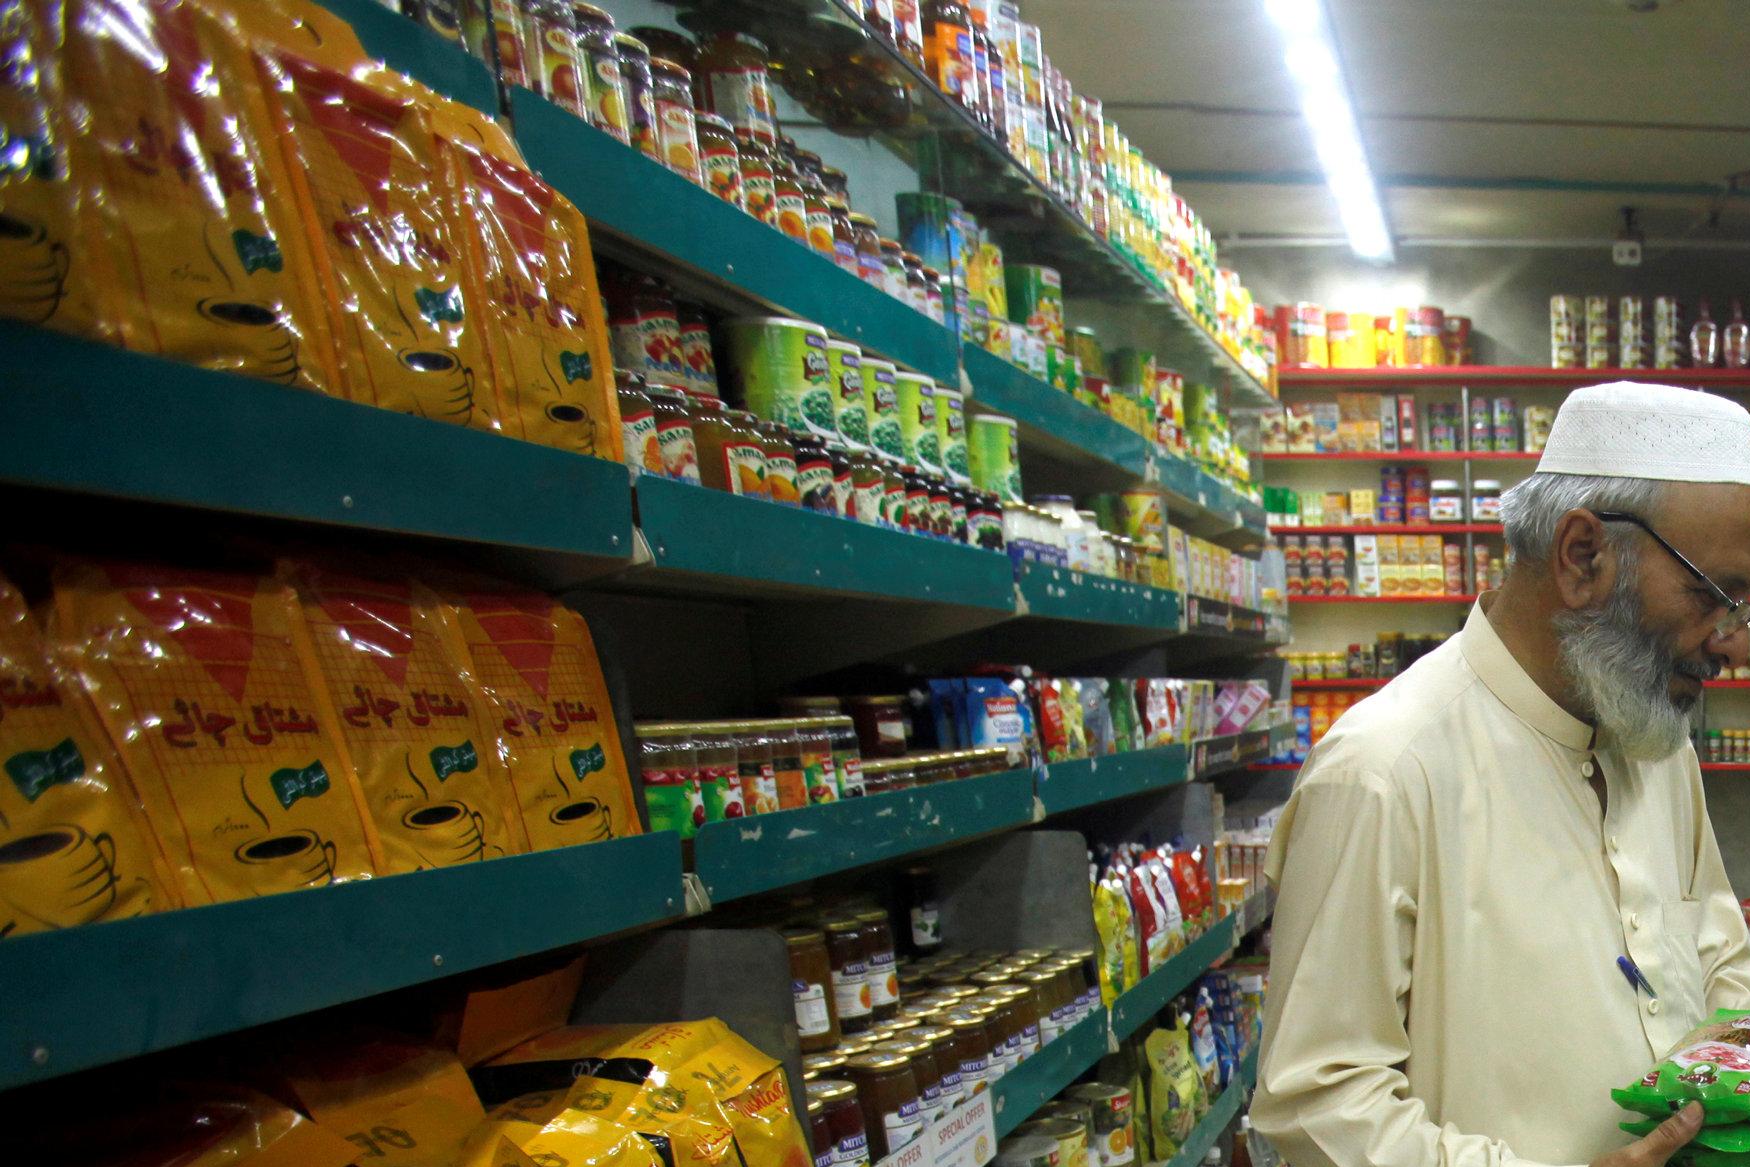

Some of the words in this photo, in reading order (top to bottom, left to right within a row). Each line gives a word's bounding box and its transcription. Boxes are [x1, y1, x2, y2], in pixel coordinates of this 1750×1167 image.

[243, 702, 320, 746] مشتاق
[406, 691, 469, 730] مشتاق
[550, 700, 598, 733] مشتاق
[938, 1120, 964, 1145] SPECIAL
[964, 1102, 986, 1128] OFFER
